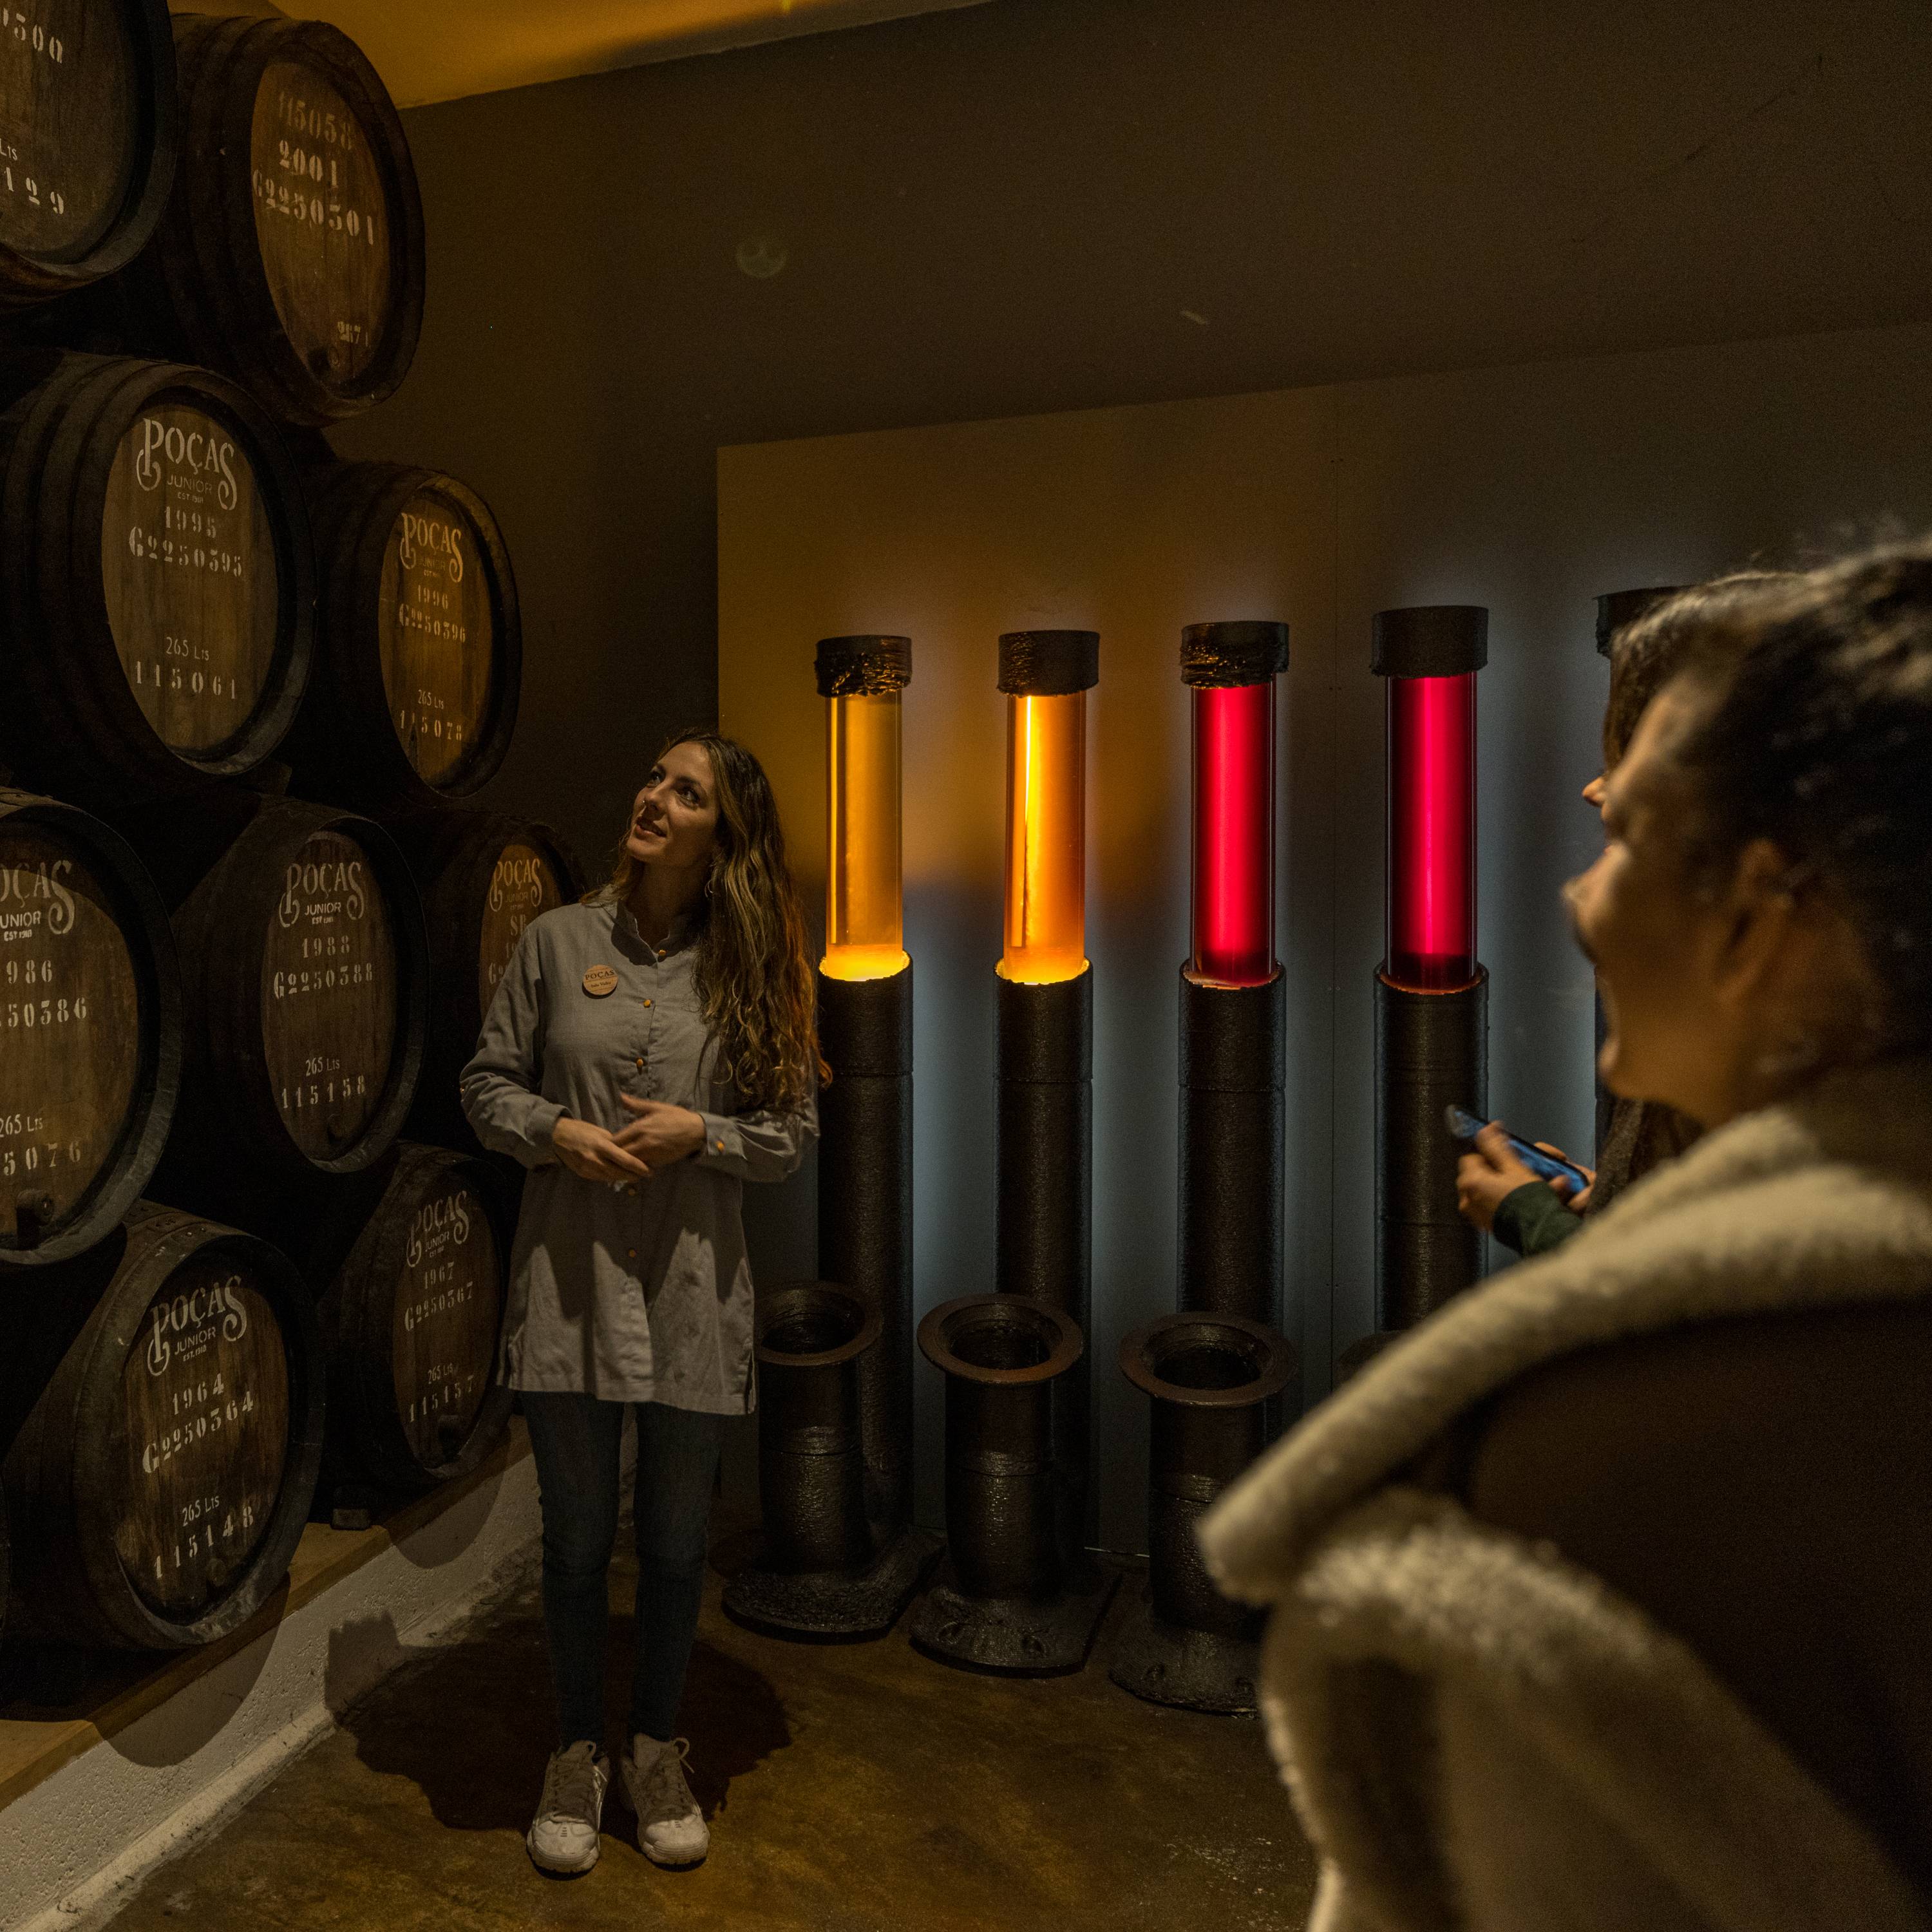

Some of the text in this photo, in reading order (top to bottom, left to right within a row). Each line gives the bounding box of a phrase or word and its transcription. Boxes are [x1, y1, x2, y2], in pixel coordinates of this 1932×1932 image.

[279, 139, 338, 188] 2001
[136, 418, 238, 511] POÇAS
[166, 473, 213, 495] JUNIOR
[164, 506, 217, 538] 1995
[399, 511, 464, 583] POÇAS
[417, 584, 449, 610] 1996
[166, 636, 189, 658] 265
[135, 661, 236, 699] 115061
[418, 688, 432, 706] 265
[279, 860, 365, 929] POÇAS
[489, 857, 542, 913] POÇAS
[303, 901, 342, 916] JUNIOR
[301, 934, 350, 959] 1988
[585, 969, 614, 980] POÇAS
[305, 1056, 323, 1077] 265
[406, 1190, 469, 1268] POÇAS
[425, 1230, 450, 1253] JUNIOR
[424, 1261, 454, 1290] 1967
[147, 1274, 248, 1376] POÇAS
[174, 1326, 216, 1356] JUNIOR
[427, 1365, 442, 1385] 265
[172, 1372, 225, 1416] 1964
[182, 1499, 201, 1527] 265
[154, 1505, 254, 1579] 115148
